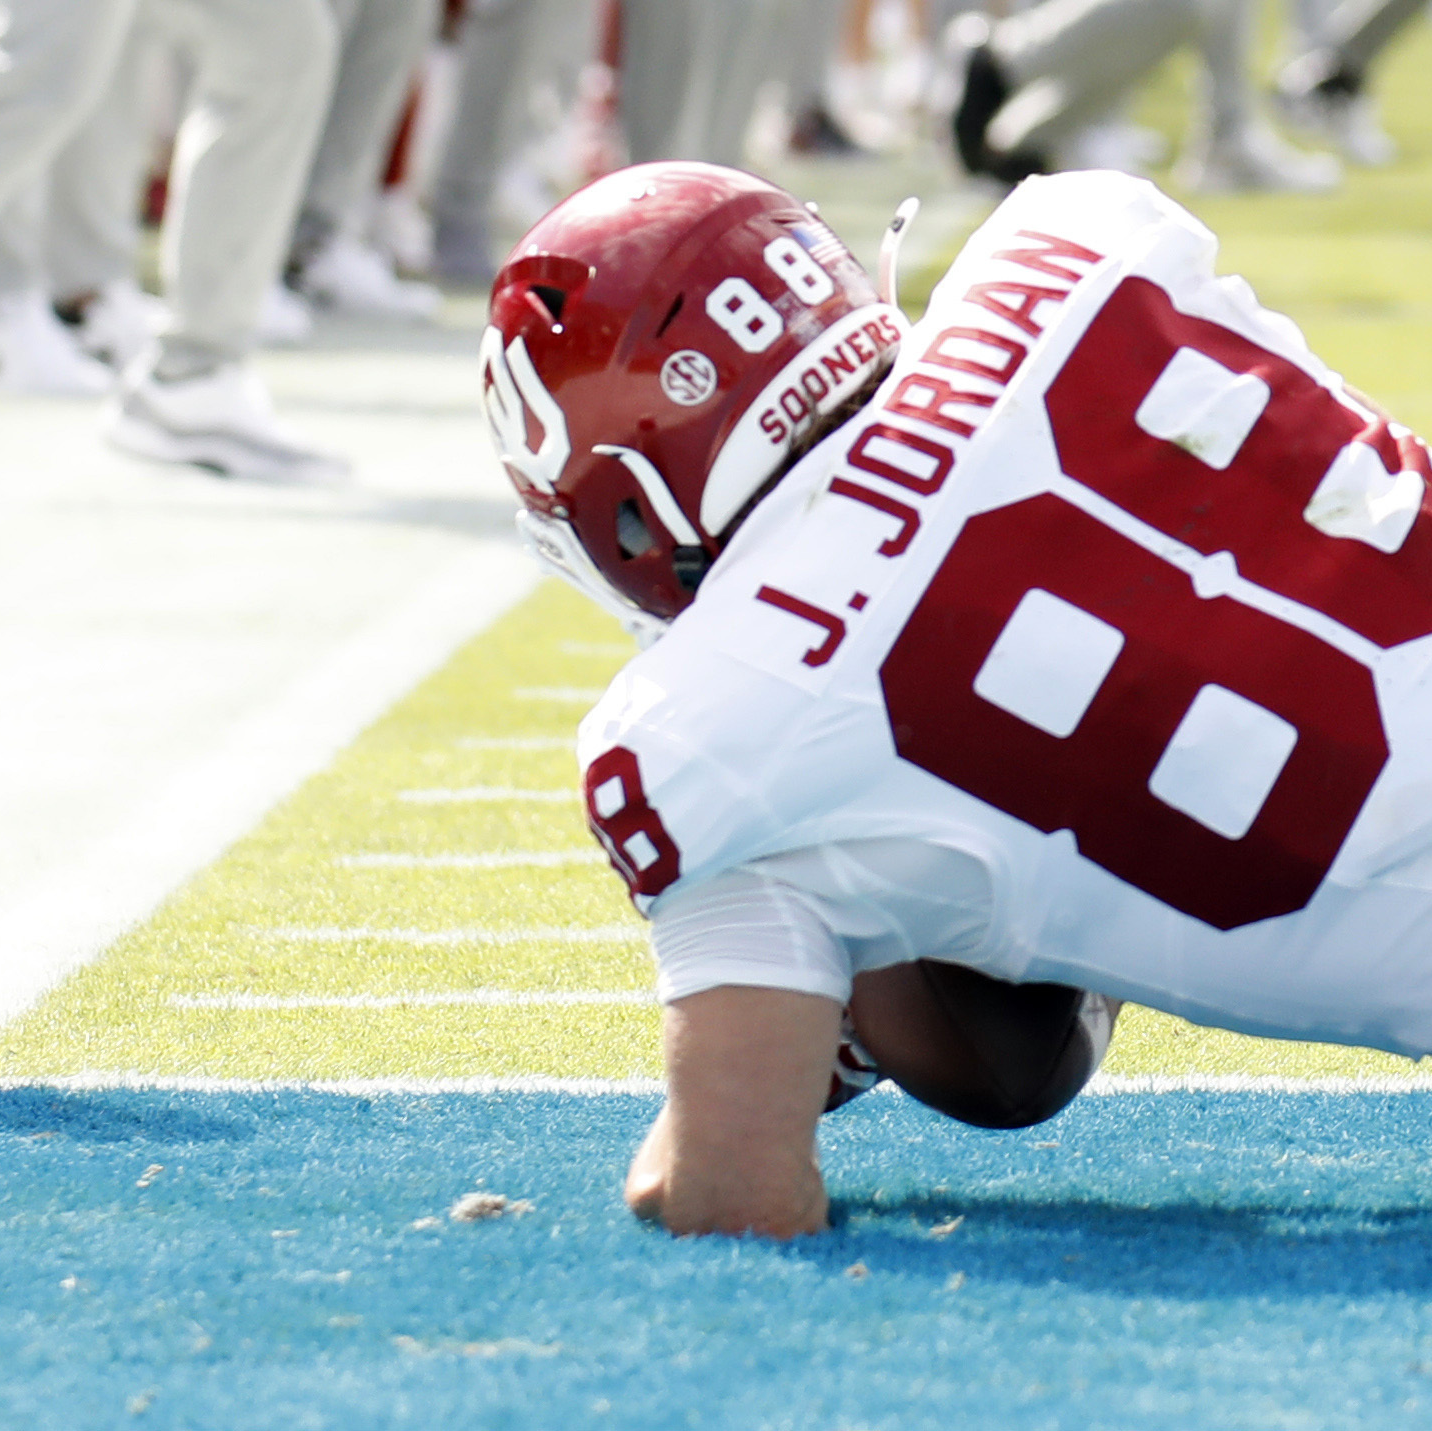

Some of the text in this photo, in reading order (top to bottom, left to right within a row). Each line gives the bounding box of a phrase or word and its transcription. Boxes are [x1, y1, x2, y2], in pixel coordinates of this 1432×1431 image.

[705, 236, 835, 354] 88
[665, 353, 712, 402] SEC
[759, 314, 902, 445] SOONERS
[755, 228, 1107, 668] J. JORDAN
